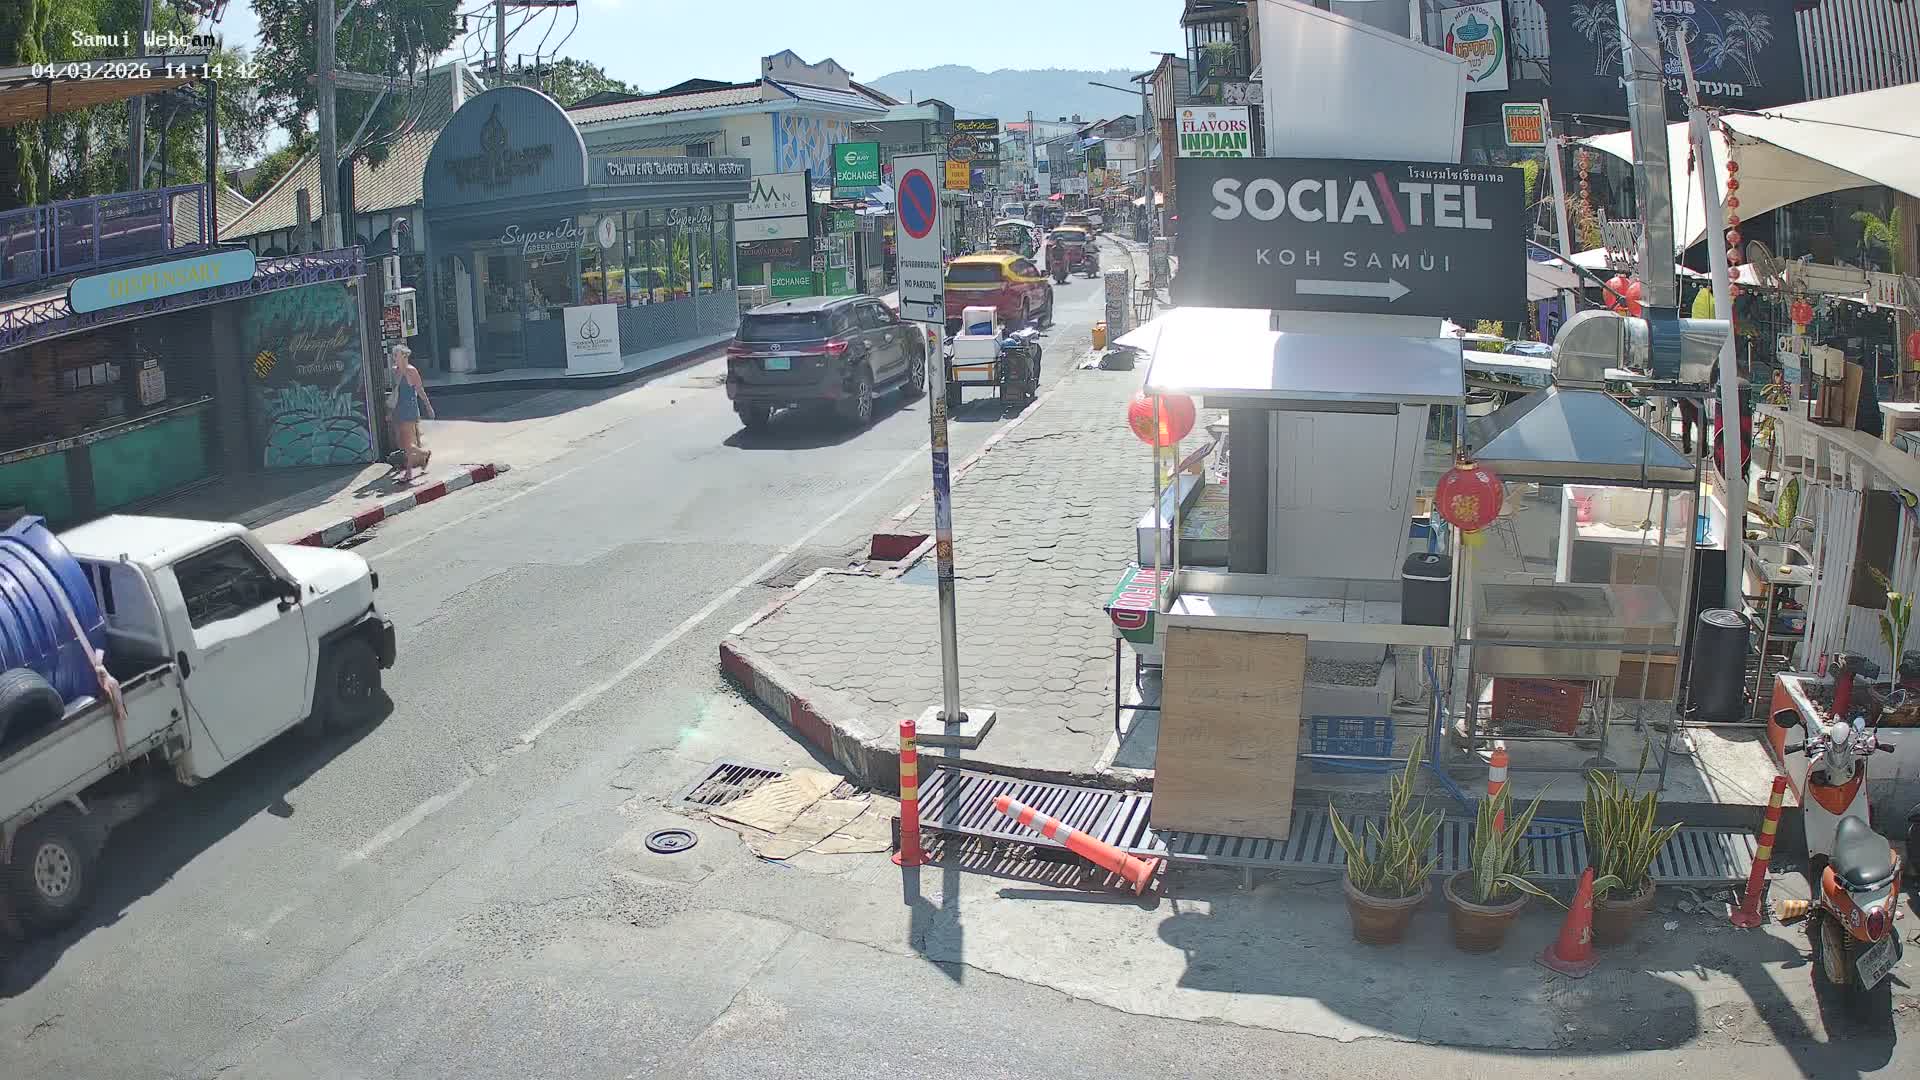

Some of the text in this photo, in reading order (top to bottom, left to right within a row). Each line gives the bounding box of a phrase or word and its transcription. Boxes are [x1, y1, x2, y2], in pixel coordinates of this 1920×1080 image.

[1455, 6, 1489, 21] MEXICAN FOOD
[1183, 120, 1247, 133] FLAVORS
[1507, 115, 1540, 128] INDIAN
[1181, 132, 1248, 150] INDIAN
[1510, 128, 1541, 142] FOOD
[608, 161, 745, 176] CHAWENG GARDEN BEACH RESORT
[837, 171, 878, 181] EXCHANGE
[1256, 249, 1450, 272] KOH SAMUI
[109, 260, 222, 299] DISPENSARY
[772, 277, 811, 286] EXCHANGE
[904, 280, 936, 290] NO PARKING
[1110, 585, 1157, 631] FOOD
